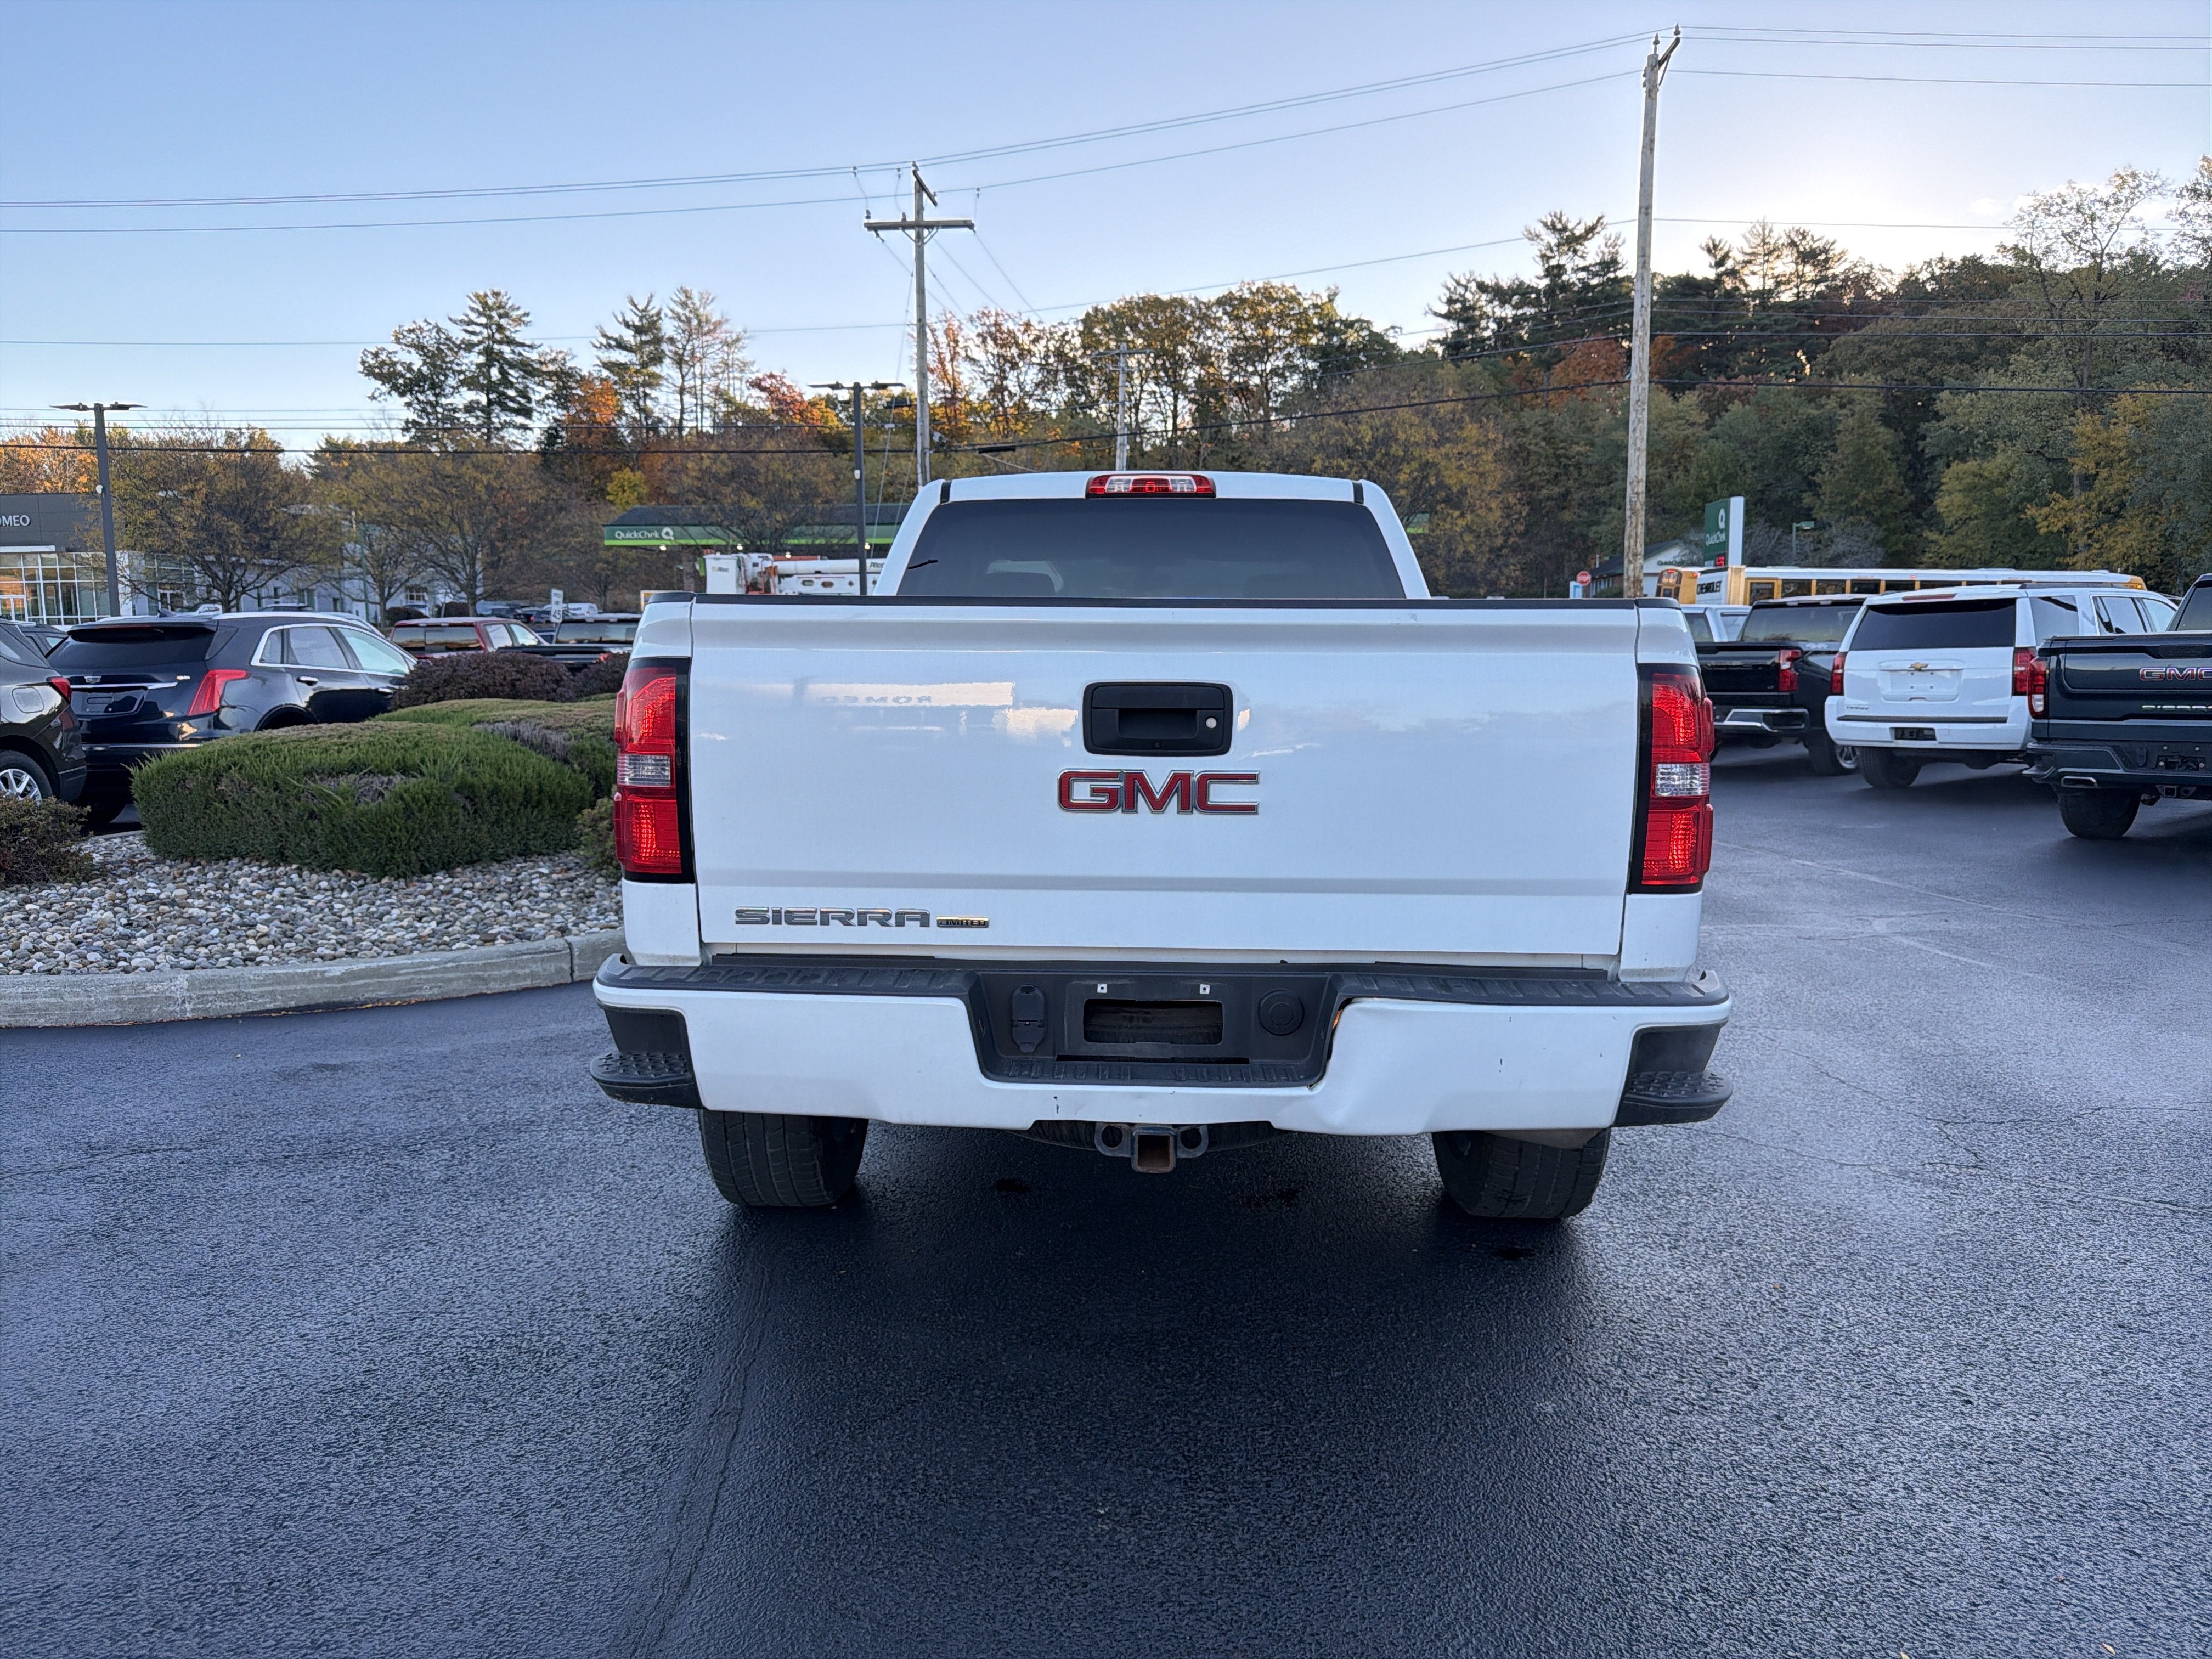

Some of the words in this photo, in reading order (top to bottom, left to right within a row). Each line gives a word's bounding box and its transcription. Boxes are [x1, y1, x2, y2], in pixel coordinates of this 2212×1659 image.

[0, 515, 30, 526] MEO
[552, 609, 561, 620] 45
[2140, 667, 2212, 681] GMC
[1057, 769, 1260, 815] GMC
[735, 907, 930, 927] SIERRA
